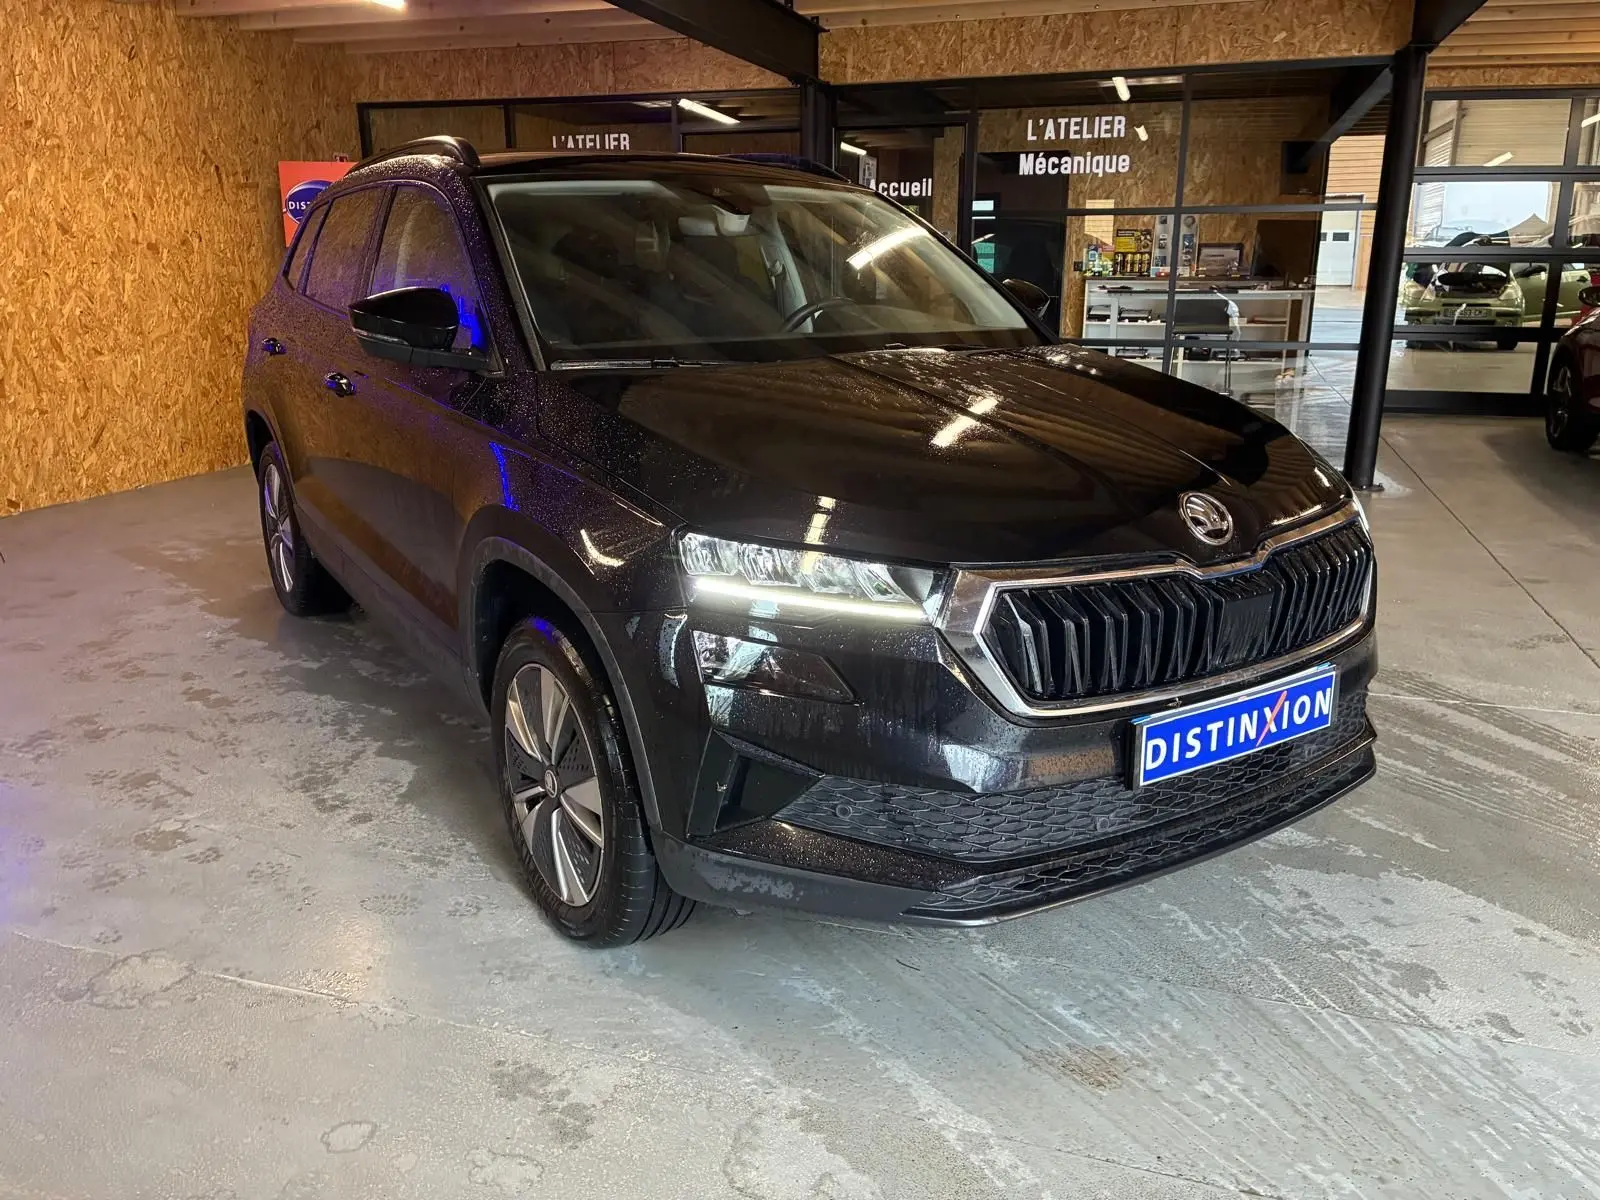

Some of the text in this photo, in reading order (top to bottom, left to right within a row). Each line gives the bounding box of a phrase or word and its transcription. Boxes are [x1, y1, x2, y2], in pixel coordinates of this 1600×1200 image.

[1027, 115, 1126, 141] L'ATELIER
[1019, 151, 1130, 177] Mécanique
[1145, 687, 1332, 771] DISTINXION
